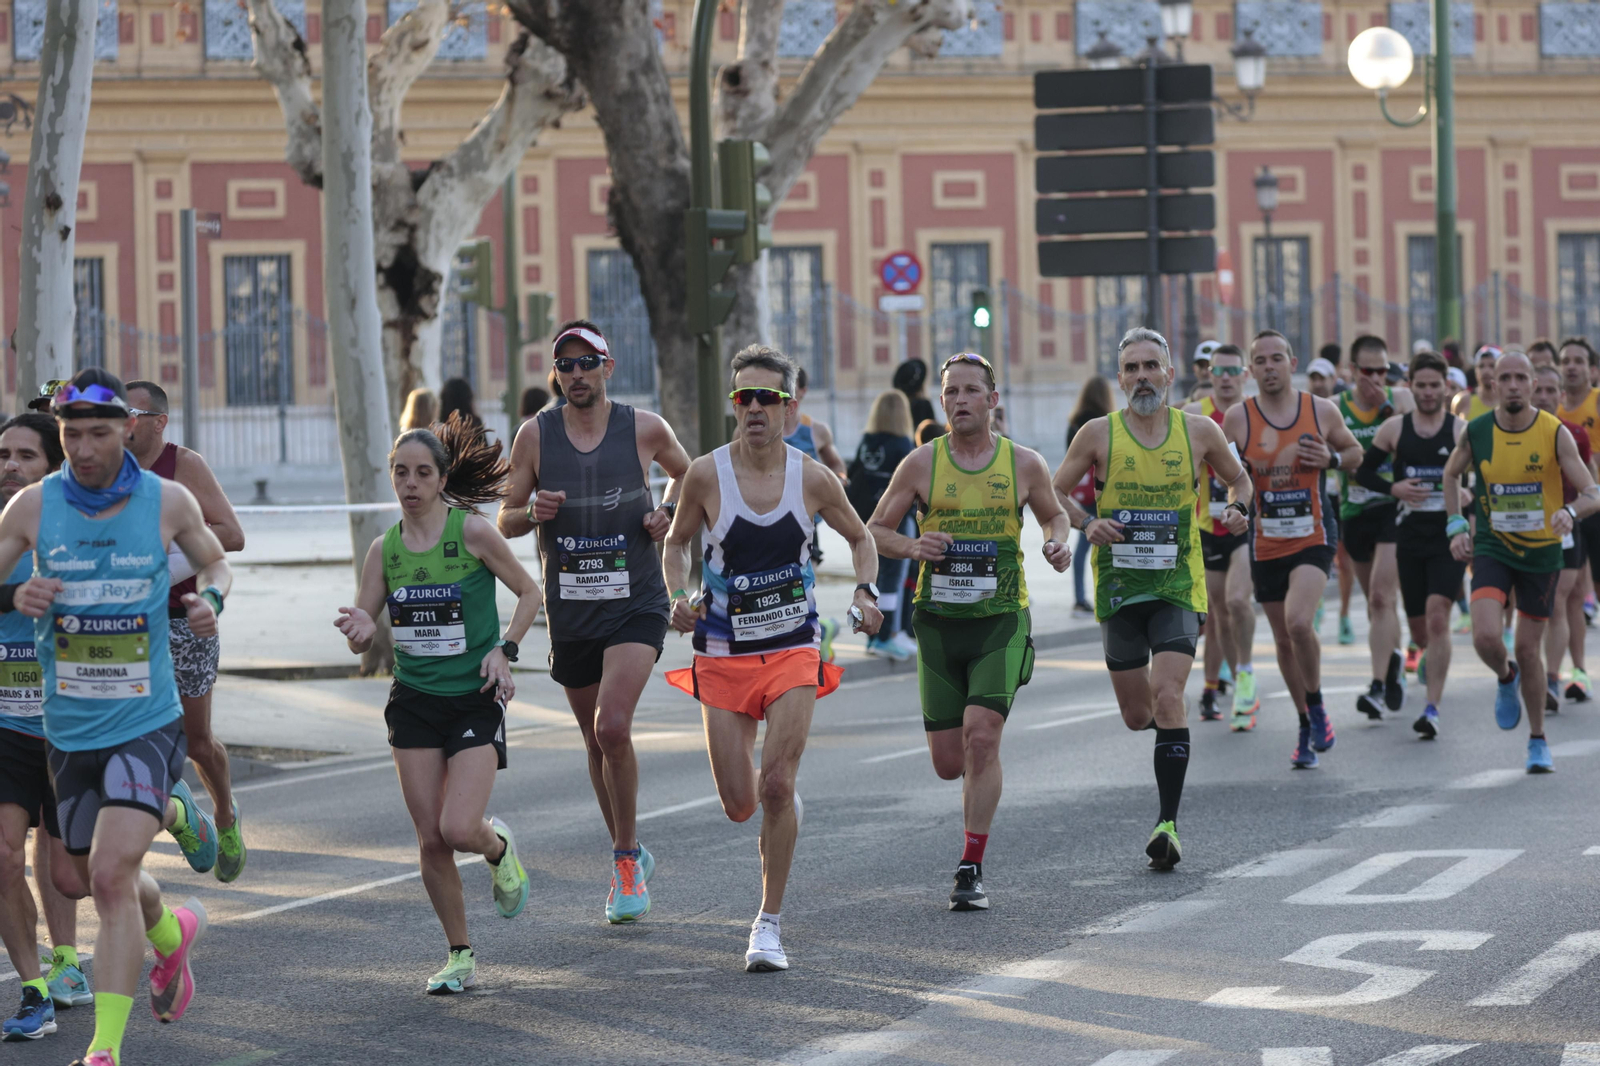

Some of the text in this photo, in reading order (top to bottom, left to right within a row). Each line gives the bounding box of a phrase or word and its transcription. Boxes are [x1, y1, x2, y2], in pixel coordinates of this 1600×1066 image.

[1114, 482, 1138, 490] CLUB
[1506, 485, 1537, 493] ZURICH
[1276, 492, 1306, 501] ZURICH
[936, 509, 960, 517] CLUB
[1134, 513, 1170, 522] ZURICH
[939, 516, 1006, 534] CAMALEÓN
[1133, 532, 1156, 540] 2885
[578, 538, 618, 549] ZURICH
[950, 544, 988, 552] ZURICH
[1134, 546, 1154, 554] TRON
[578, 558, 604, 570] 2793
[950, 562, 974, 573] 2884
[576, 575, 609, 584] RAMAPO
[752, 568, 794, 586] ZURICH
[948, 578, 974, 587] ISRAEL
[410, 588, 451, 598] ZURICH
[756, 592, 780, 608] 1923
[412, 610, 436, 622] 2711
[738, 606, 804, 626] FERNANDO G.M.
[83, 619, 138, 631] ZURICH
[414, 628, 441, 638] MARIA
[10, 648, 36, 658] ZURI
[88, 646, 113, 659] 885
[12, 672, 38, 682] 1050
[76, 666, 128, 678] CARMONA
[0, 690, 22, 698] ARLOS
[24, 690, 31, 698] &
